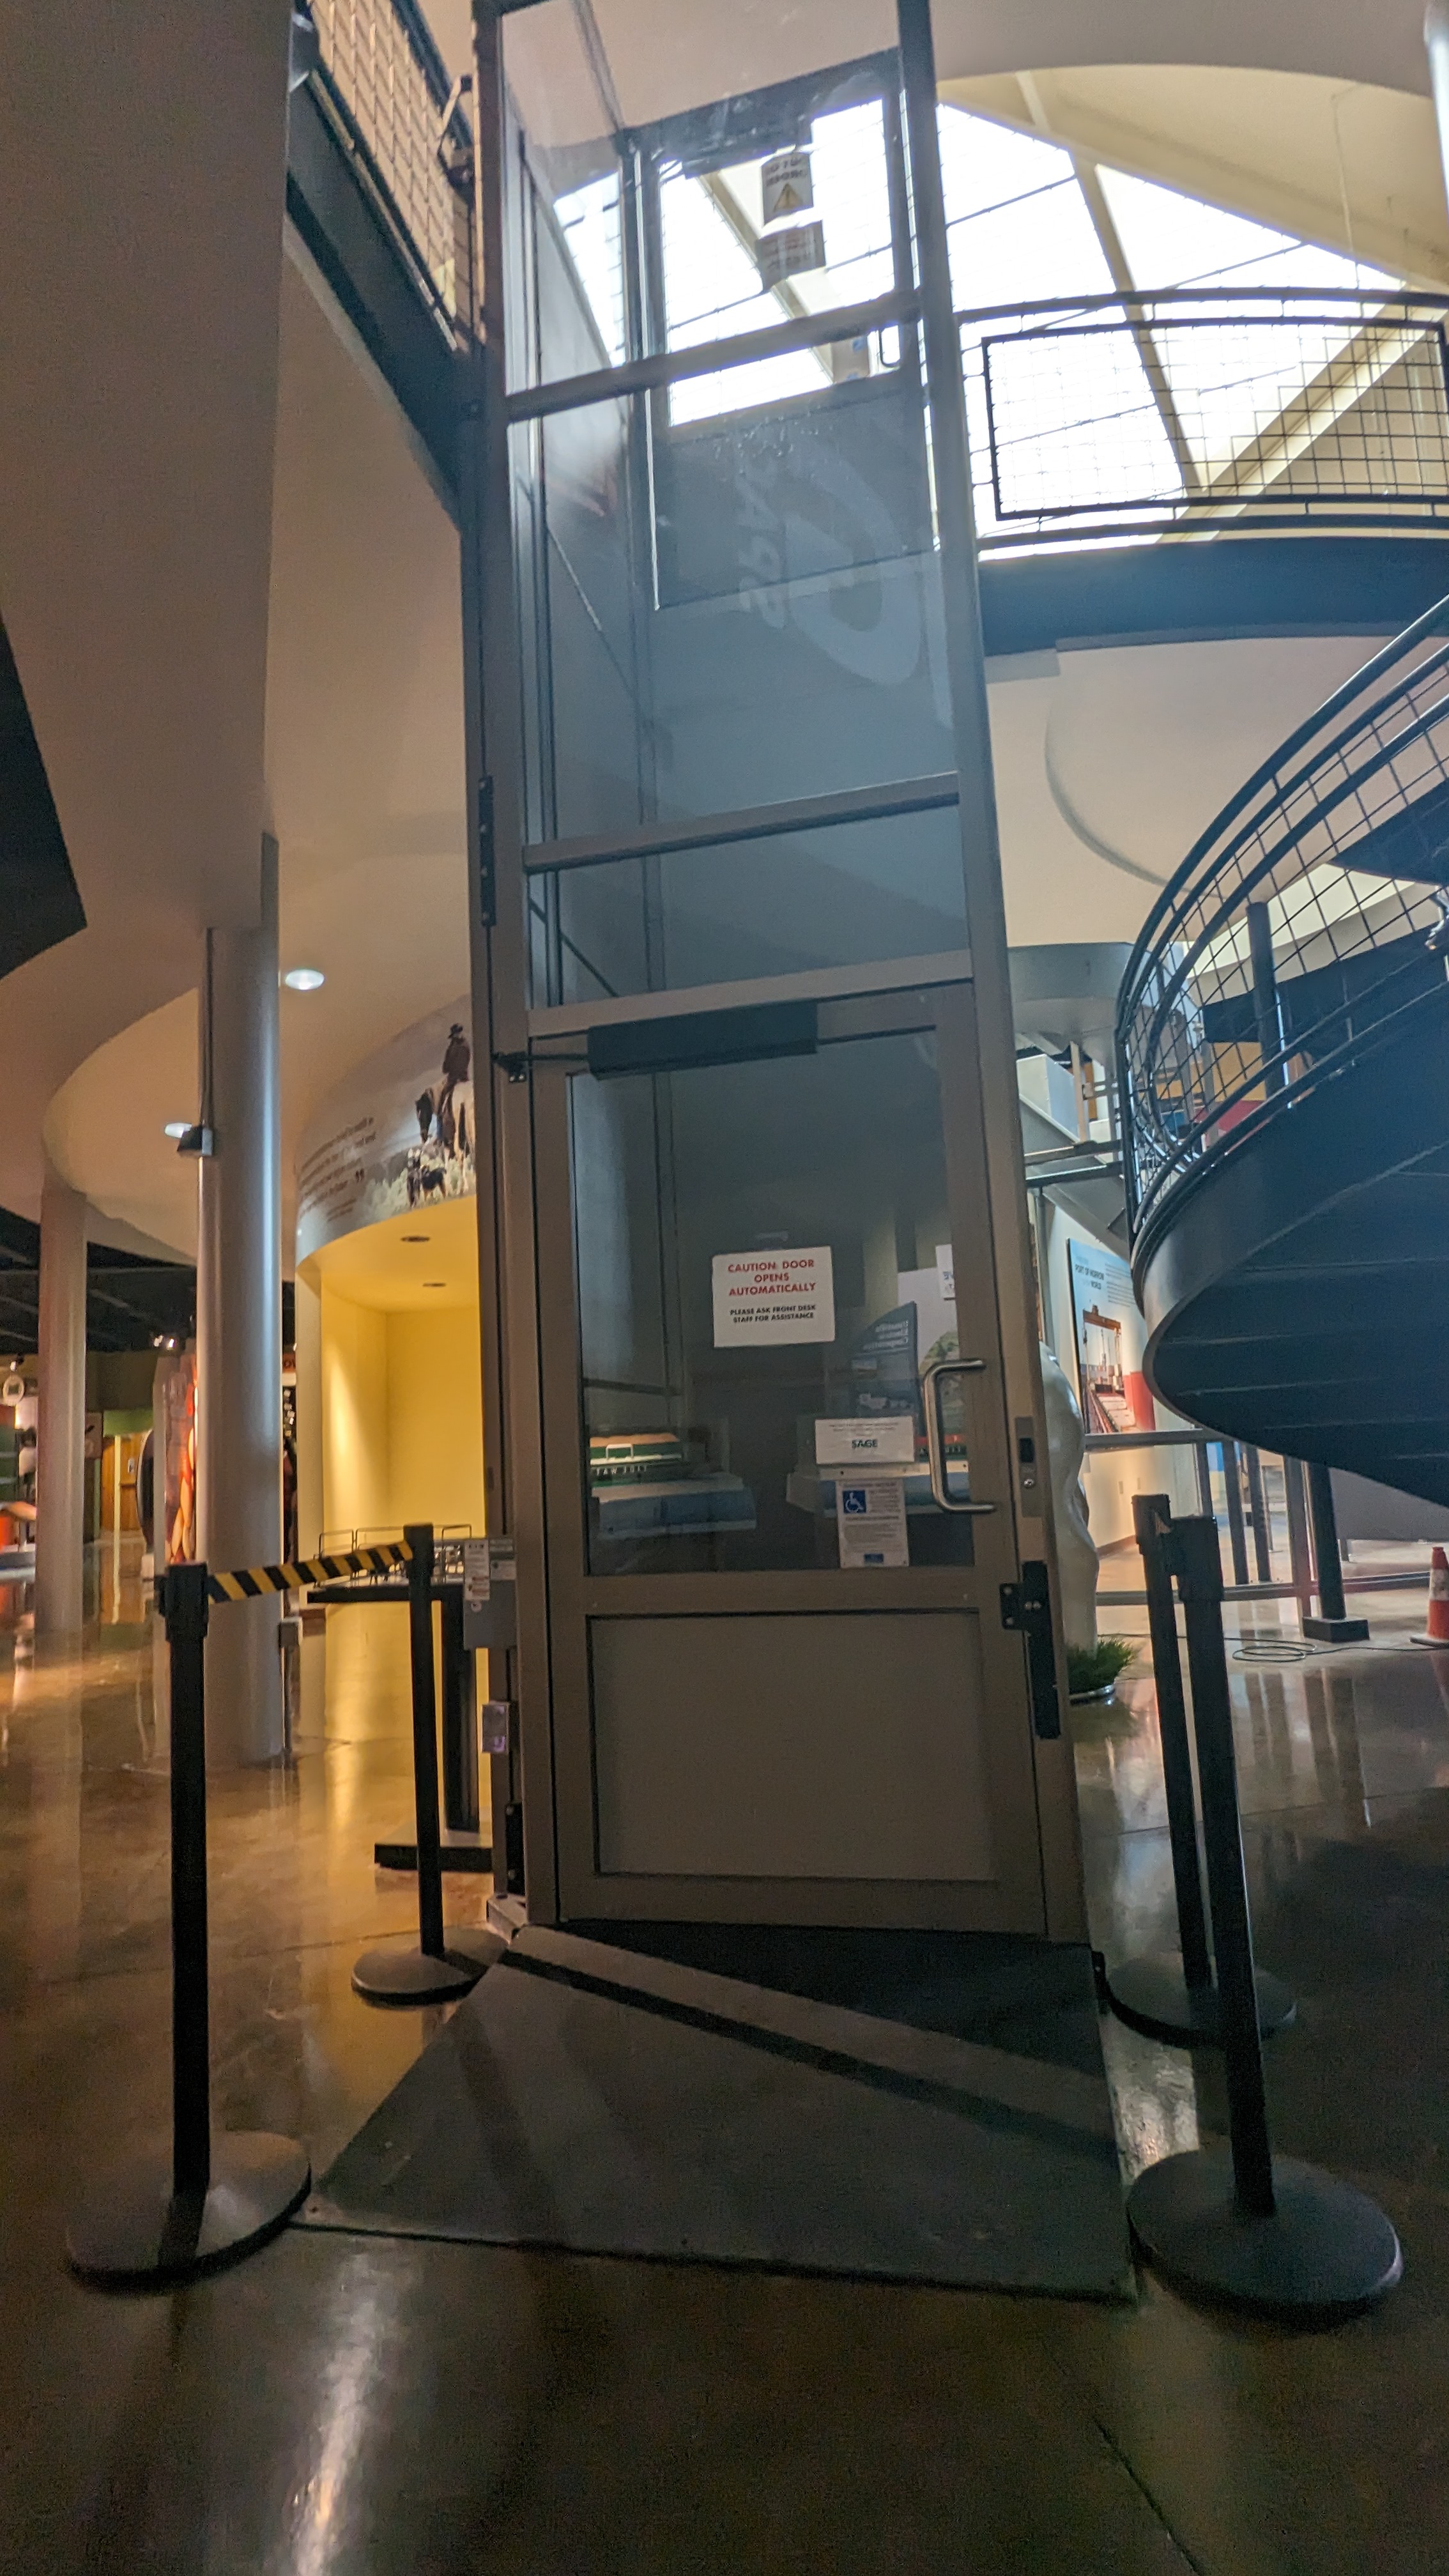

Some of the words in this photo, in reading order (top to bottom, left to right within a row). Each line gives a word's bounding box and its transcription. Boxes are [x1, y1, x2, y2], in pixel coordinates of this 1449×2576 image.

[728, 1261, 776, 1273] CAUTION
[782, 1259, 815, 1269] DOOR
[754, 1272, 790, 1283] OPENS
[728, 1282, 816, 1296] AUTOMATICALLY
[770, 1312, 814, 1321] ASSISTANCE
[852, 1439, 878, 1448] SAGE
